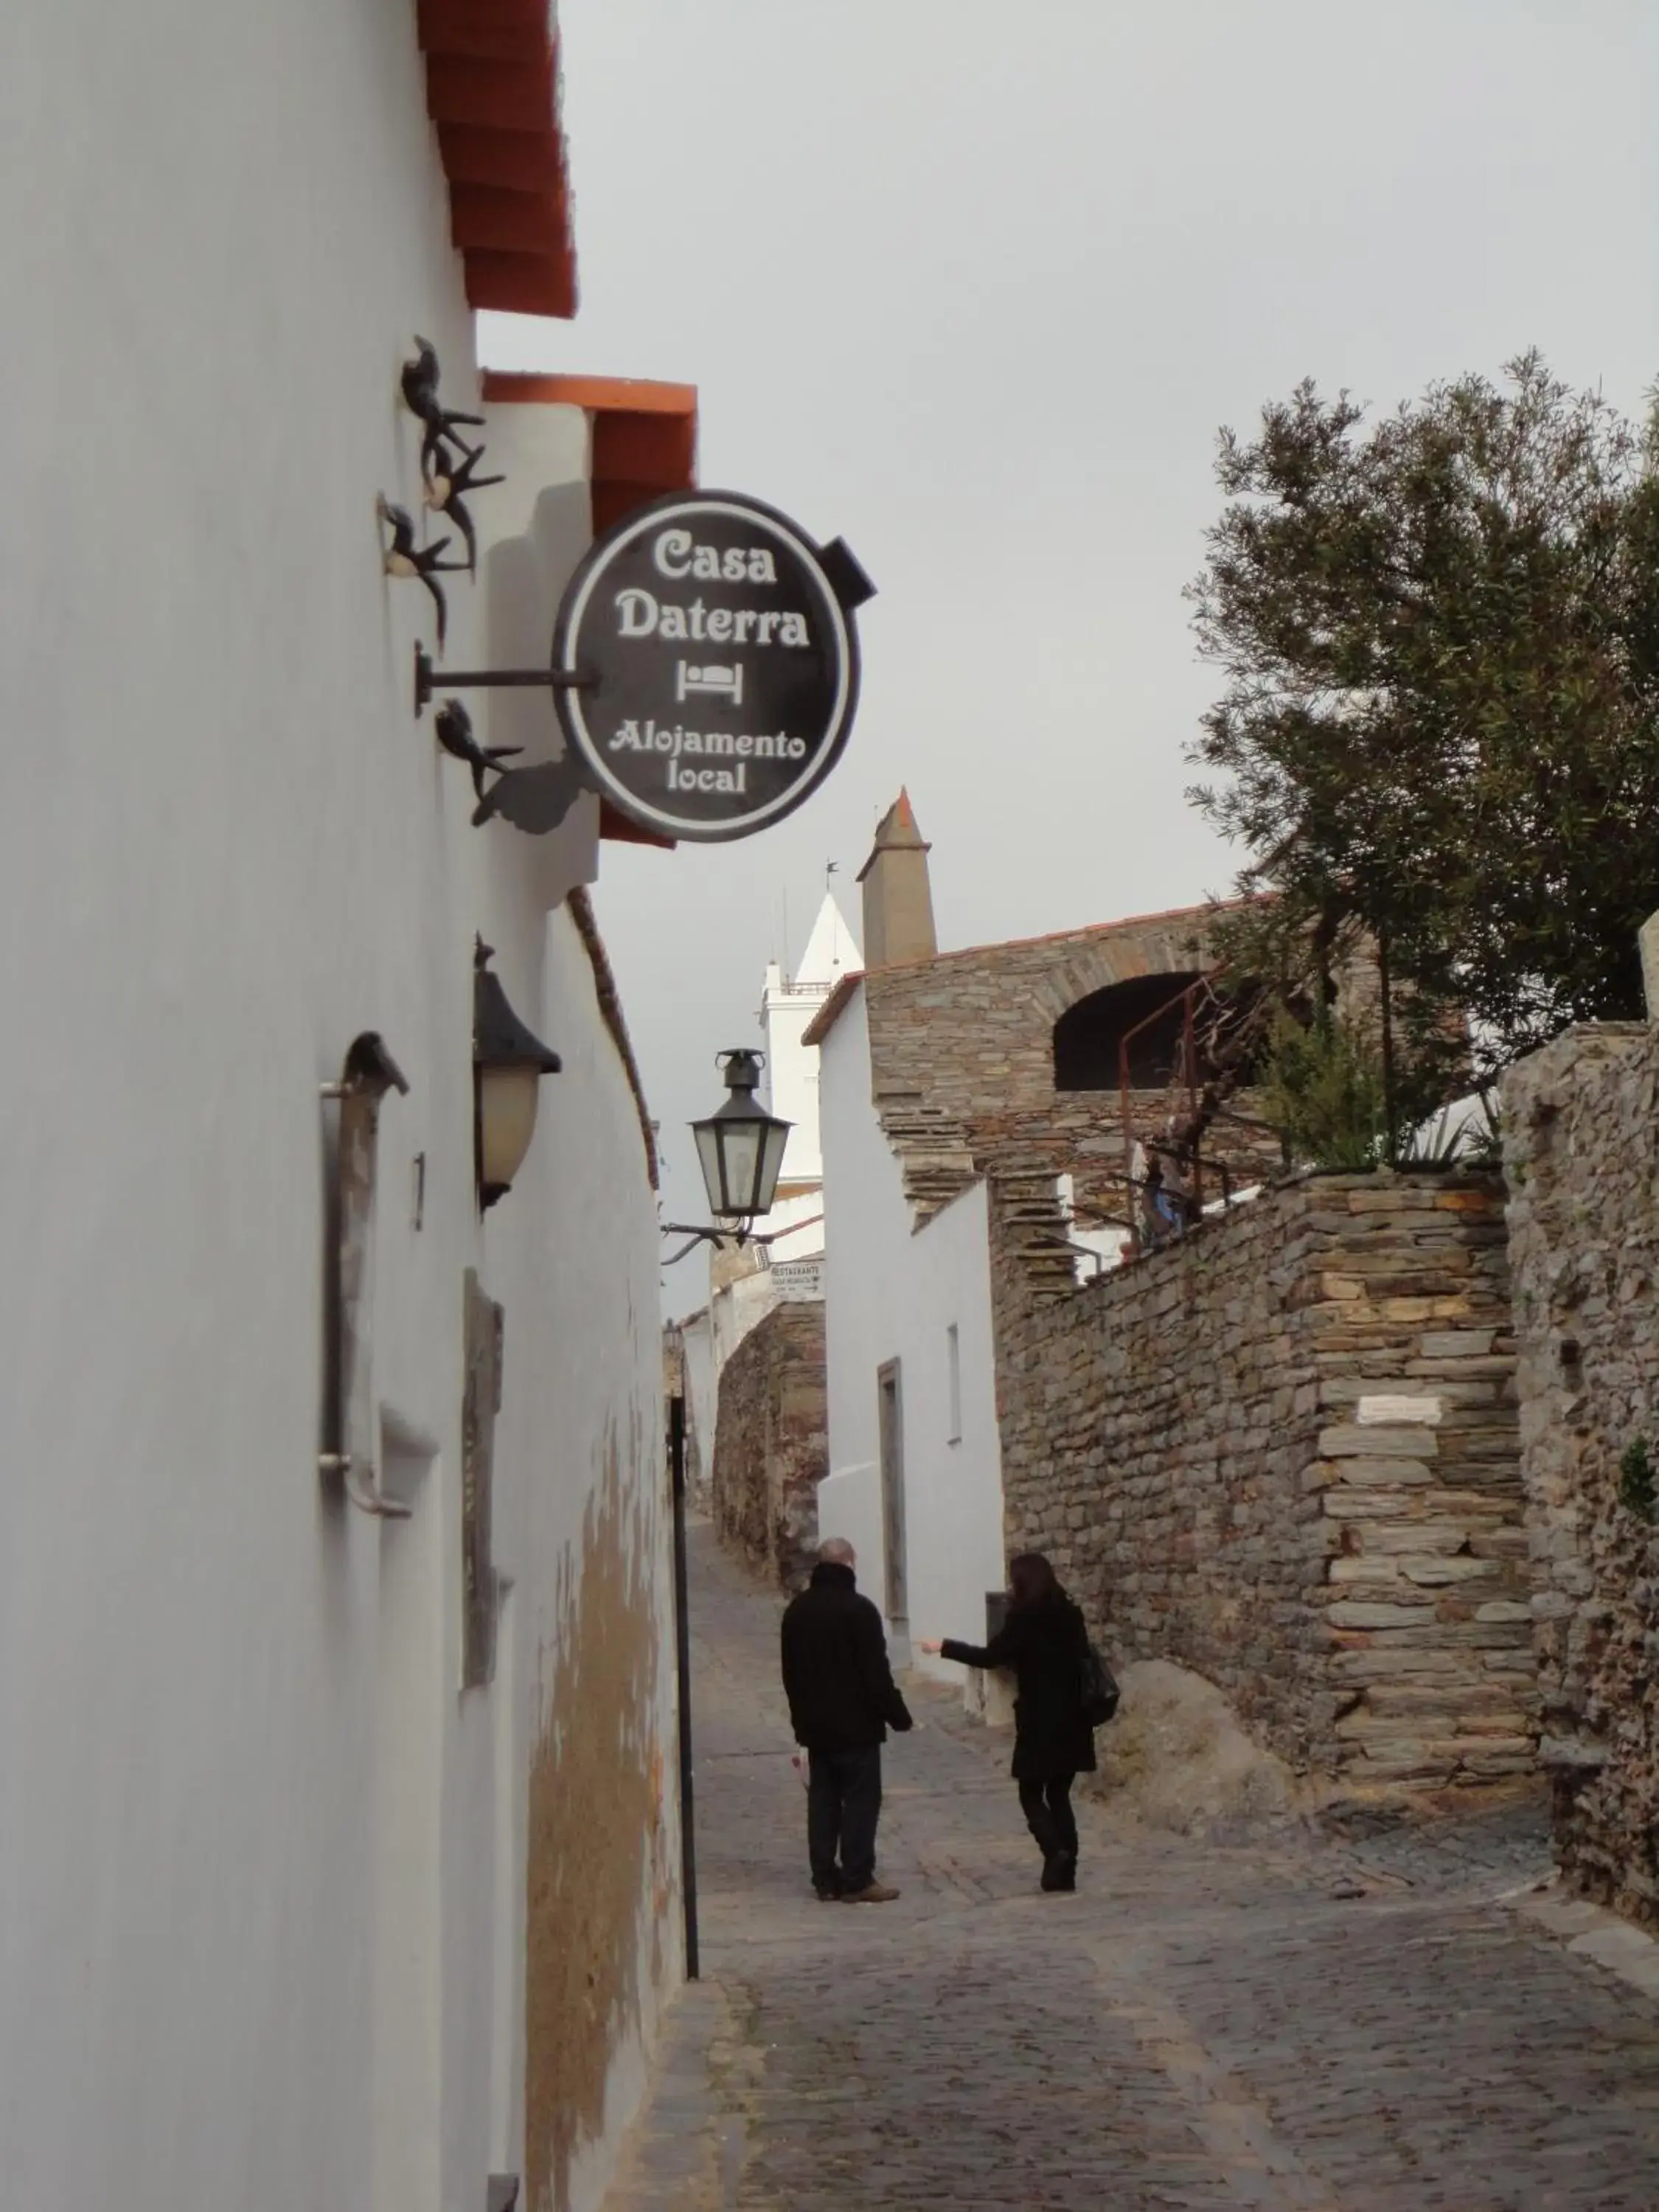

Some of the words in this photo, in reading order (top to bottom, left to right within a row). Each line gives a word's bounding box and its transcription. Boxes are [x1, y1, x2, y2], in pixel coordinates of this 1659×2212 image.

[655, 529, 777, 583] Casa
[614, 588, 810, 646] Daterra
[608, 719, 806, 759] Alojamento
[667, 759, 745, 793] local
